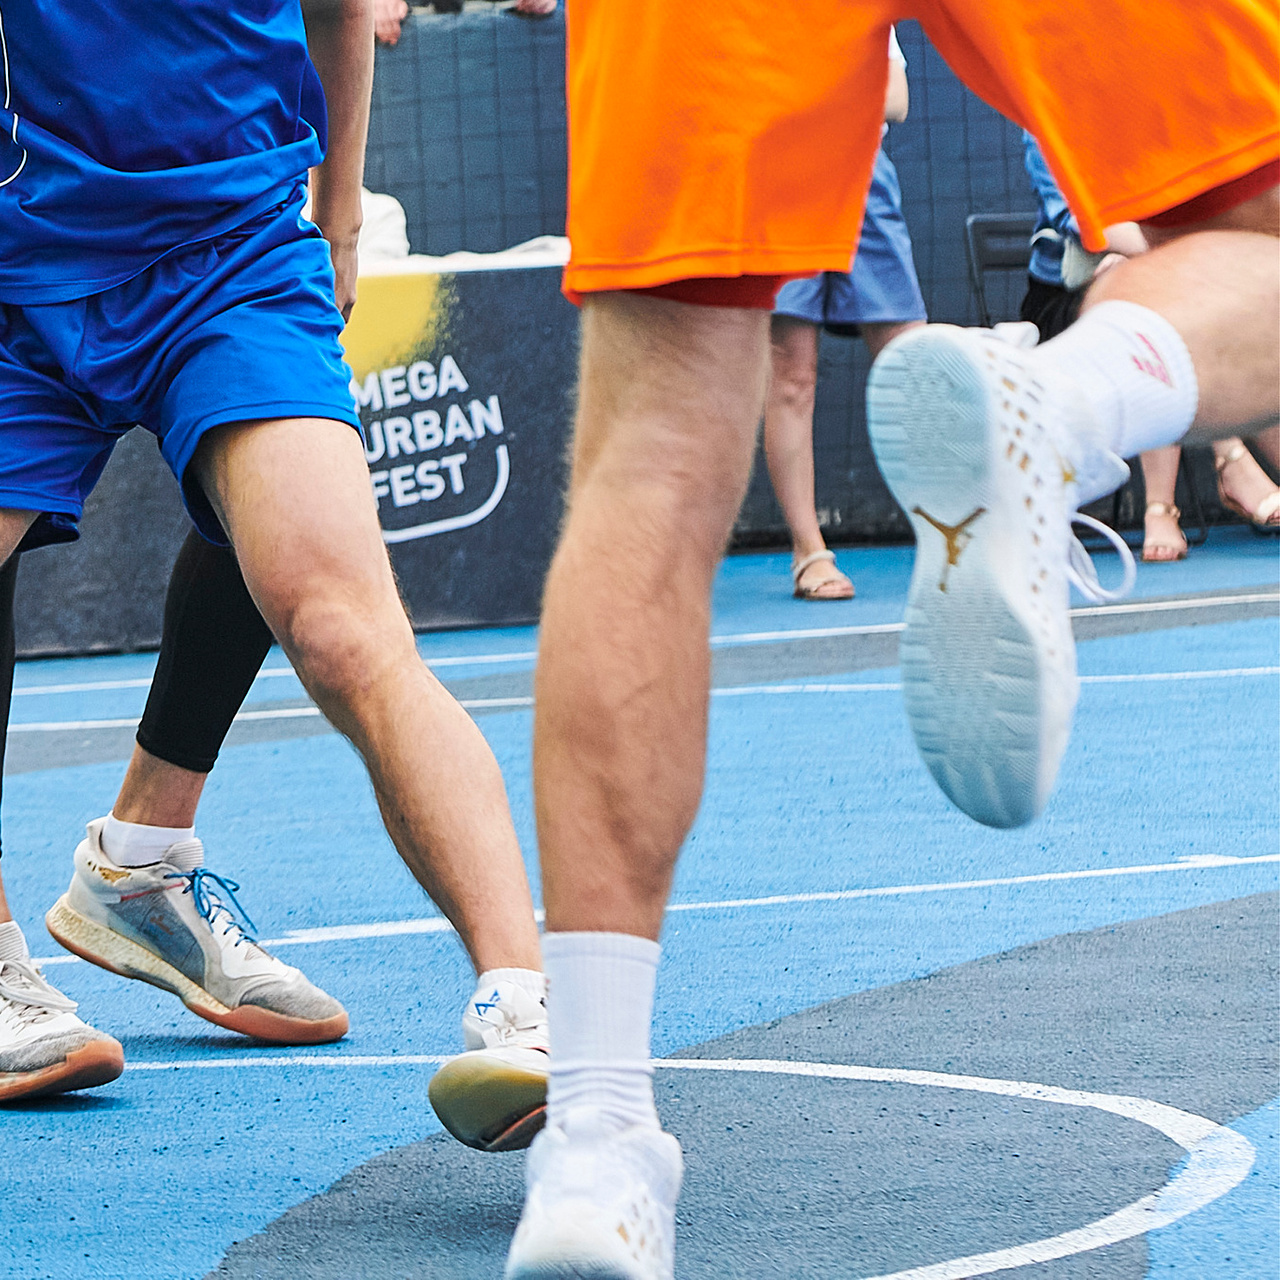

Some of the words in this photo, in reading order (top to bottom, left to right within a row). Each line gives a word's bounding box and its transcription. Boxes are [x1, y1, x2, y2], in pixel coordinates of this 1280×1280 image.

[349, 354, 469, 414] MEGA
[364, 395, 504, 464] URBAN
[370, 452, 468, 510] FEST
